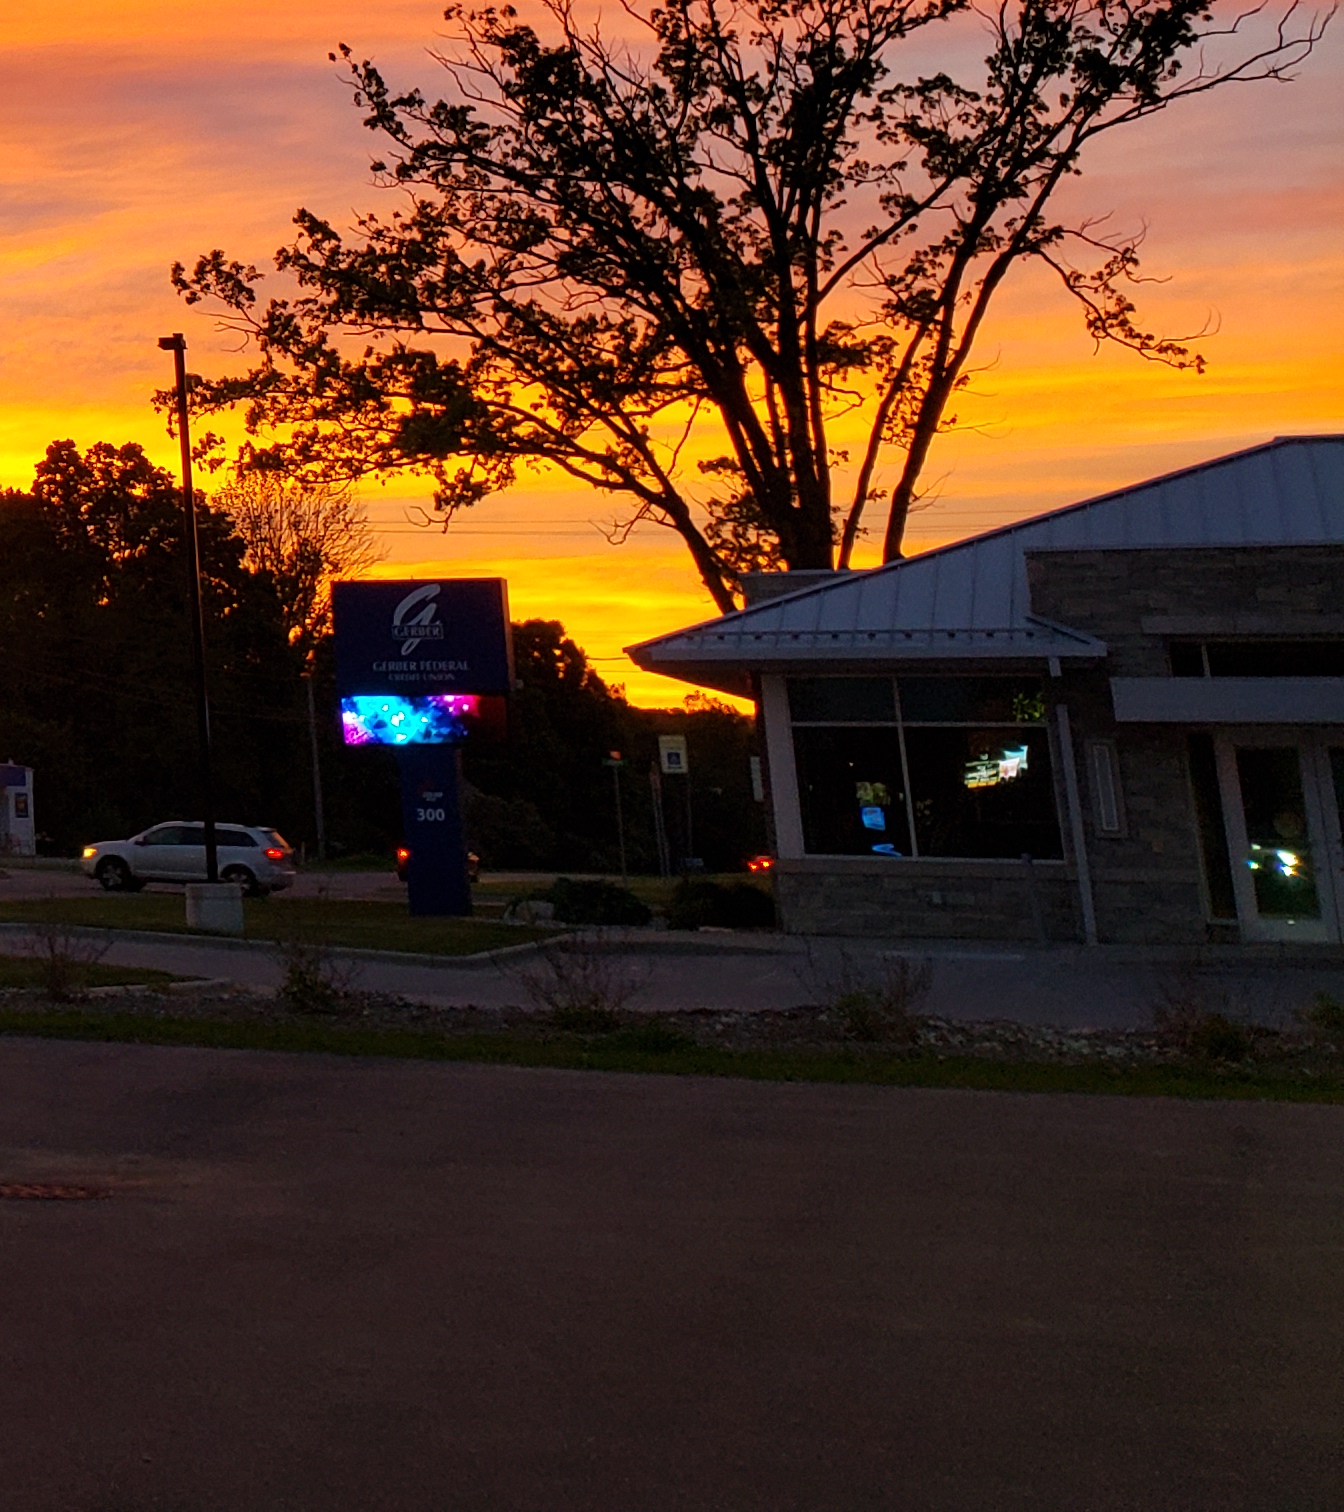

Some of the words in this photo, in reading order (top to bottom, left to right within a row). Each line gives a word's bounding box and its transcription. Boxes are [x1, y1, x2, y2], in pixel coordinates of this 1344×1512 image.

[372, 660, 417, 671] GERBER
[419, 660, 469, 671] FEDERAL
[416, 808, 445, 822] 300
